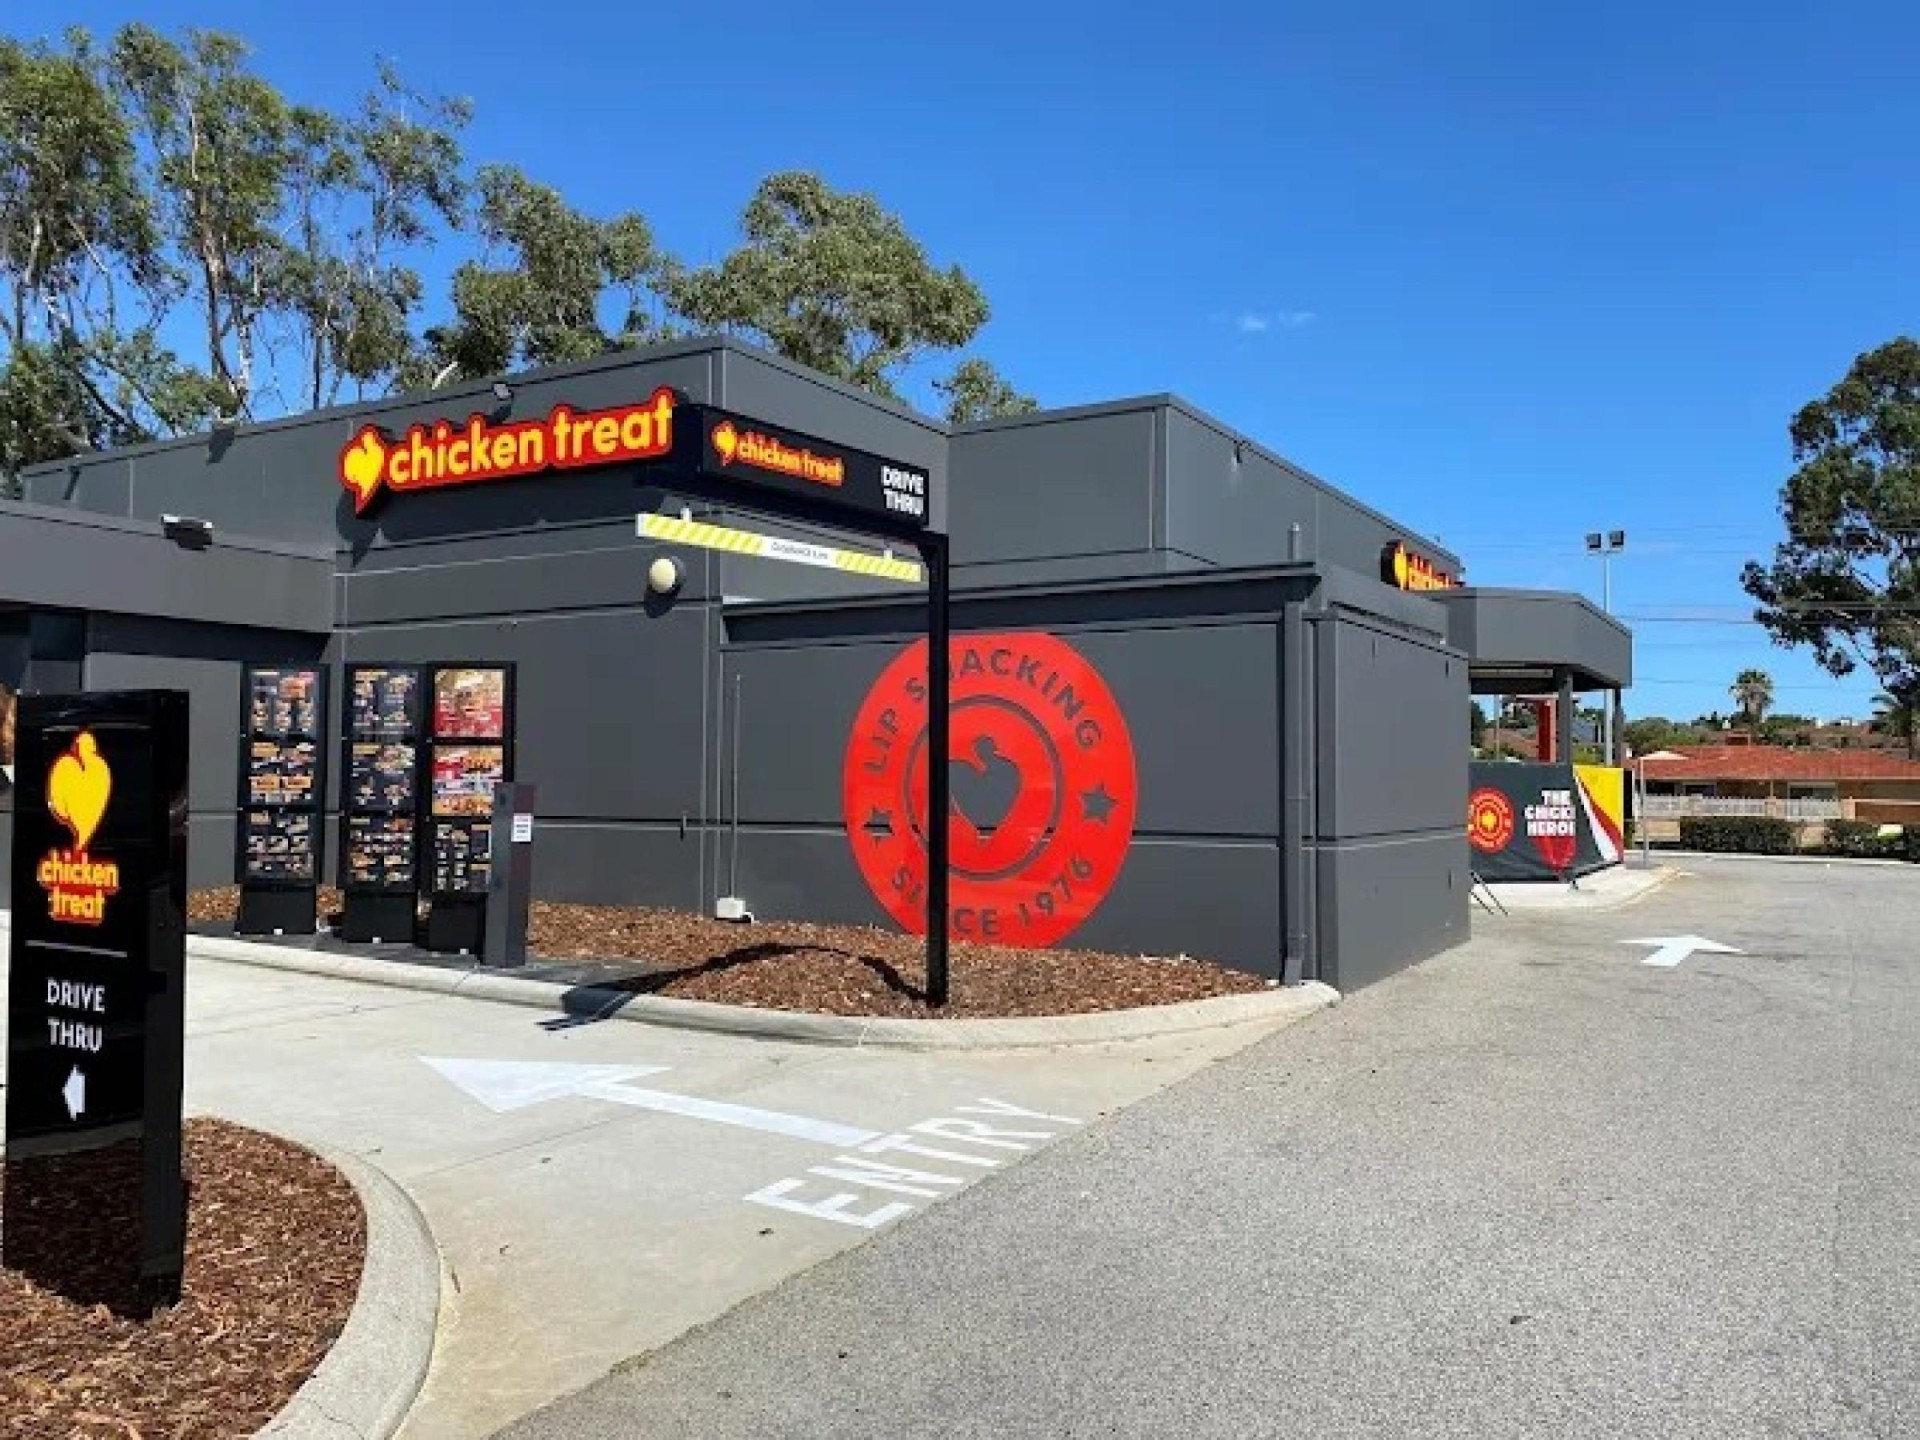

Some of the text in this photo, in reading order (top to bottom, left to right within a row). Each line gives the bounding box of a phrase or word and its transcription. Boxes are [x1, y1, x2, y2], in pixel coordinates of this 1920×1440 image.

[388, 393, 672, 483] chicken treat
[738, 431, 843, 482] chicken treat
[880, 465, 924, 495] DRIVE
[883, 488, 924, 517] THRU
[864, 648, 1101, 773] LIP SACKING
[1541, 790, 1570, 805] THE
[38, 848, 119, 888] chicken
[48, 886, 105, 919] treat
[892, 856, 1093, 936] SICE 1976
[47, 978, 105, 1013] DRIVE
[48, 1019, 103, 1052] THRU
[743, 1097, 1083, 1229] ENTRY
